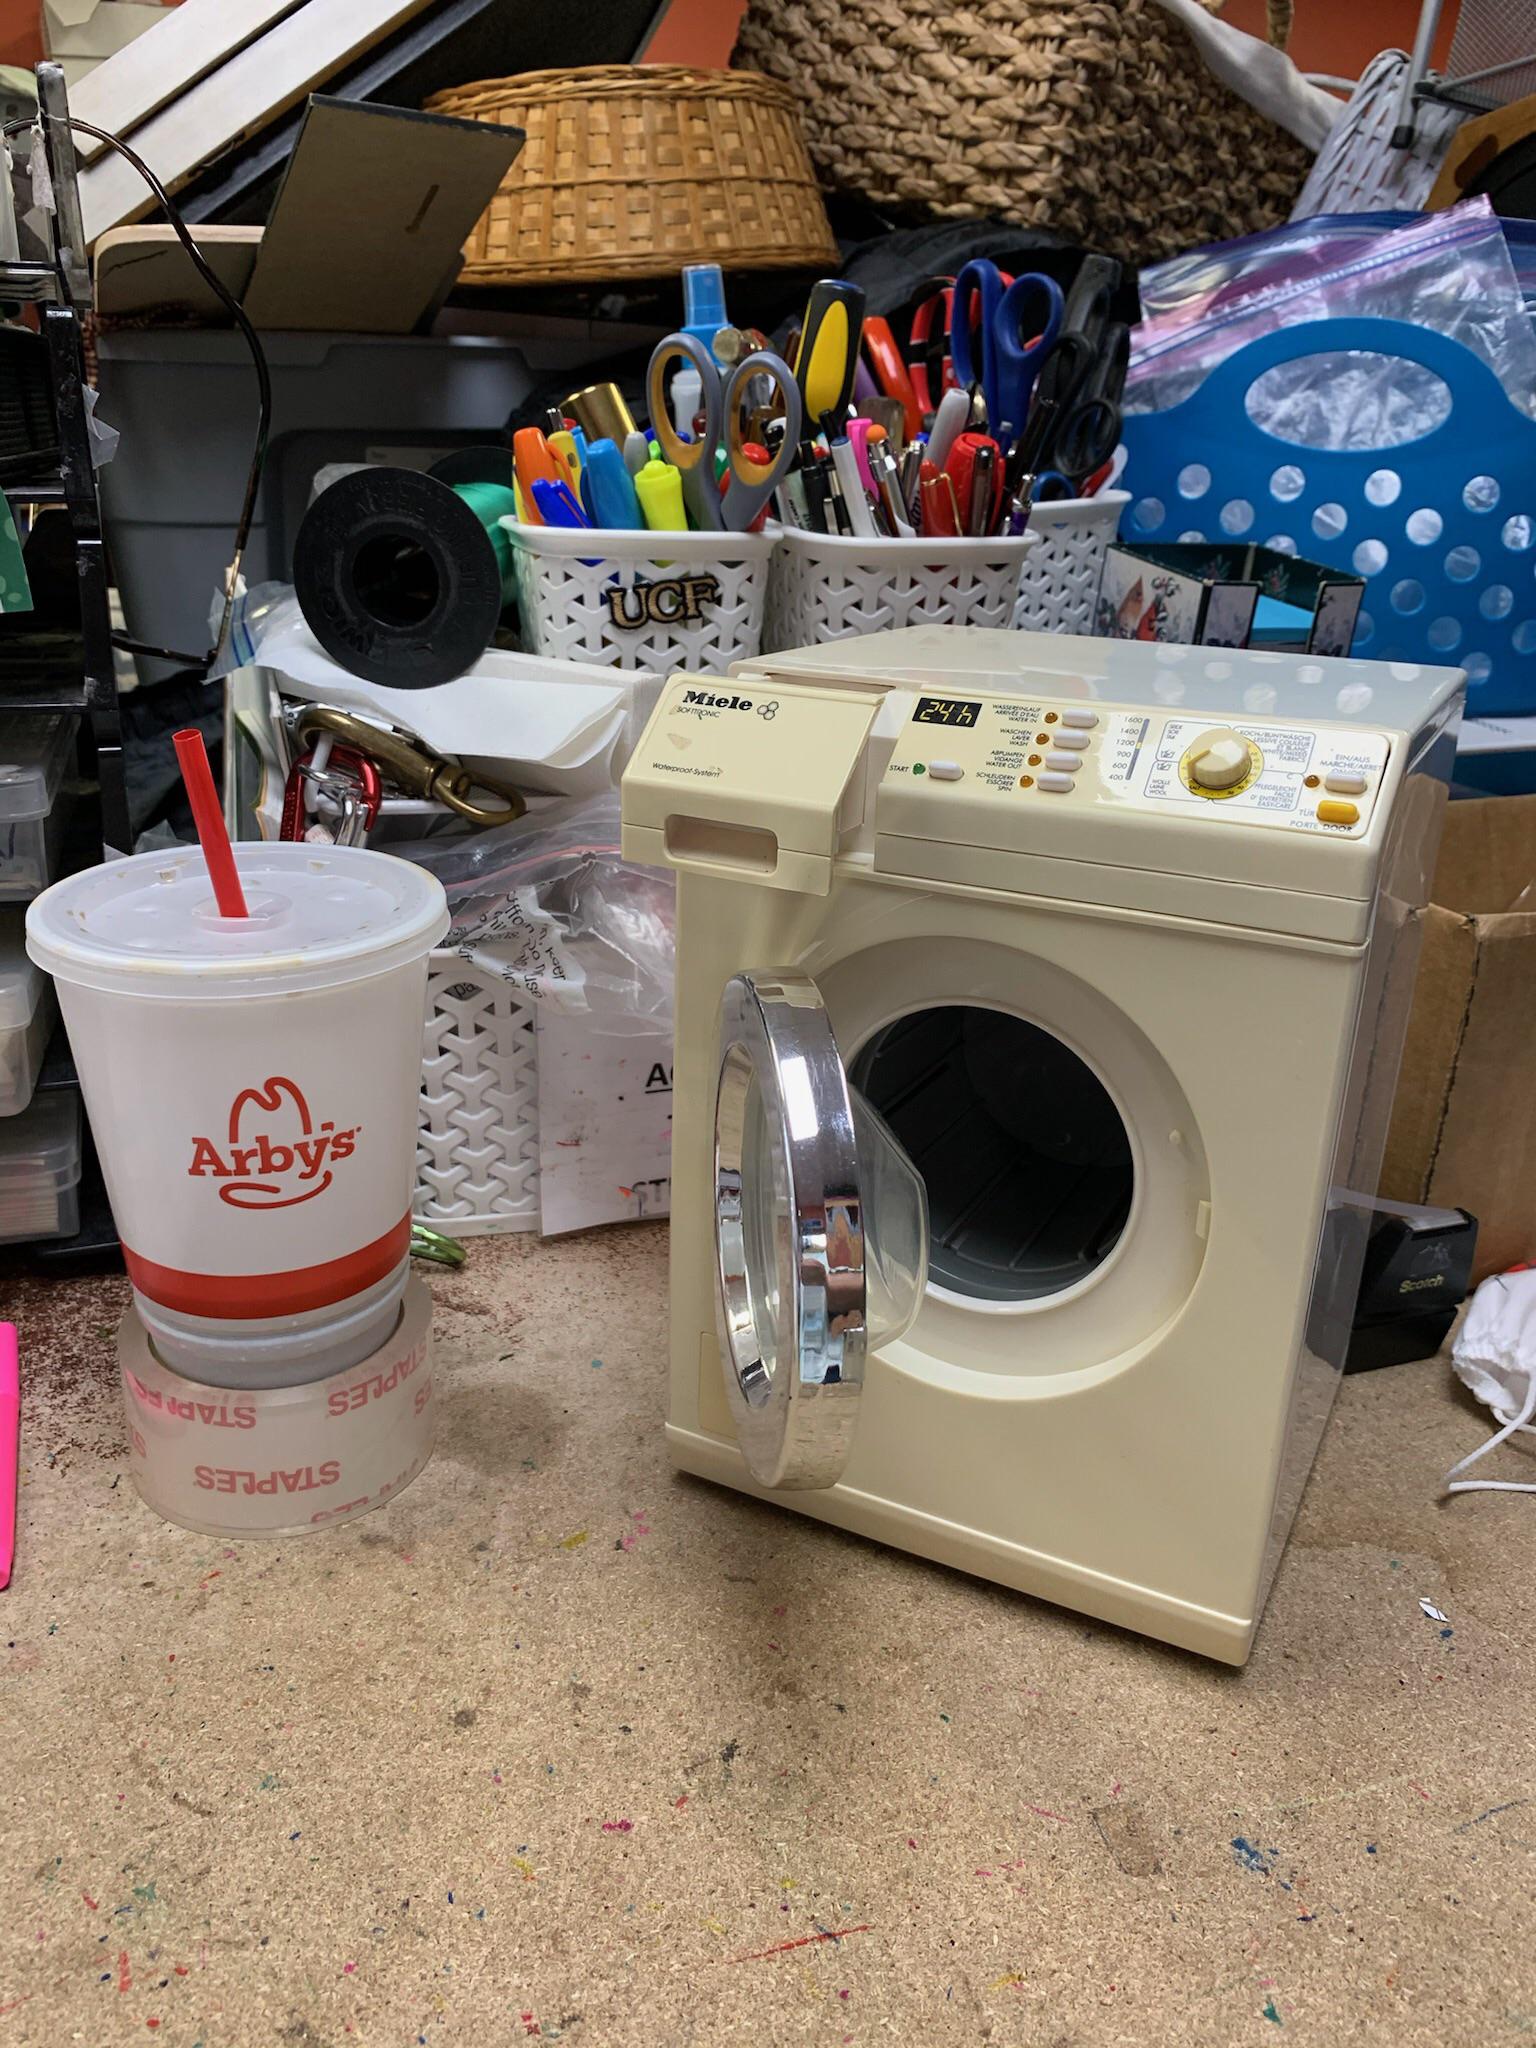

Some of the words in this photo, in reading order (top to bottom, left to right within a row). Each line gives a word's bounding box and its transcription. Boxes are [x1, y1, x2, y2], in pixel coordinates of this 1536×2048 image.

[606, 575, 720, 630] UCF
[682, 690, 753, 711] Miele
[889, 764, 909, 773] START
[1289, 820, 1319, 830] PORTE
[1322, 823, 1353, 833] DOOR
[187, 1121, 357, 1180] Arby's
[1399, 1273, 1446, 1294] Scotch
[193, 1460, 341, 1496] STAPLES
